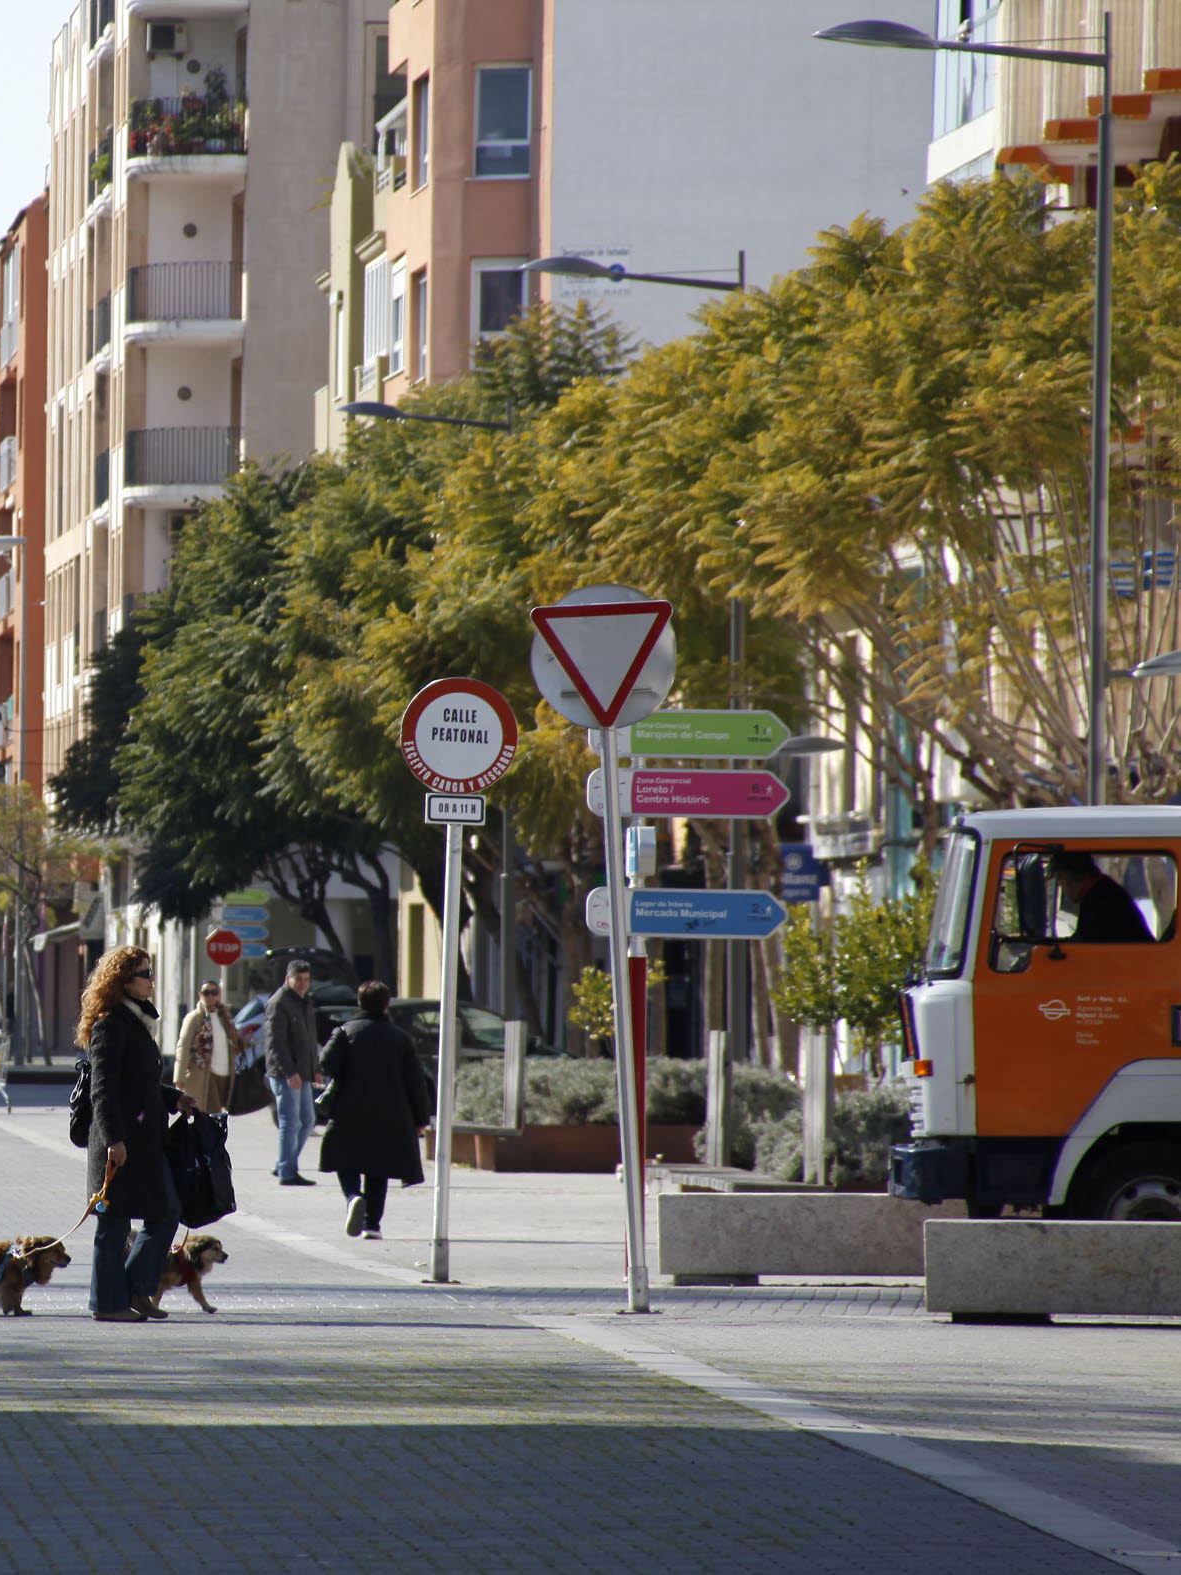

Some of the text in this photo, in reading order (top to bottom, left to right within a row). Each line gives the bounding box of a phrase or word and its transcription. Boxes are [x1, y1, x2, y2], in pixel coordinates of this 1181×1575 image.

[443, 708, 477, 723] CALLE
[753, 724, 759, 734] 1
[431, 727, 489, 744] PEATONAL
[680, 730, 693, 739] de
[694, 730, 730, 741] Campo
[403, 741, 516, 793] EXCEPTO CARGA Y DESCARGA
[636, 785, 668, 794] Loreto
[636, 795, 670, 804] Centre
[438, 802, 477, 814] 08 A 11 H
[635, 908, 728, 919] Mercado Municipal
[751, 903, 759, 913] 2
[210, 943, 239, 952] STOP
